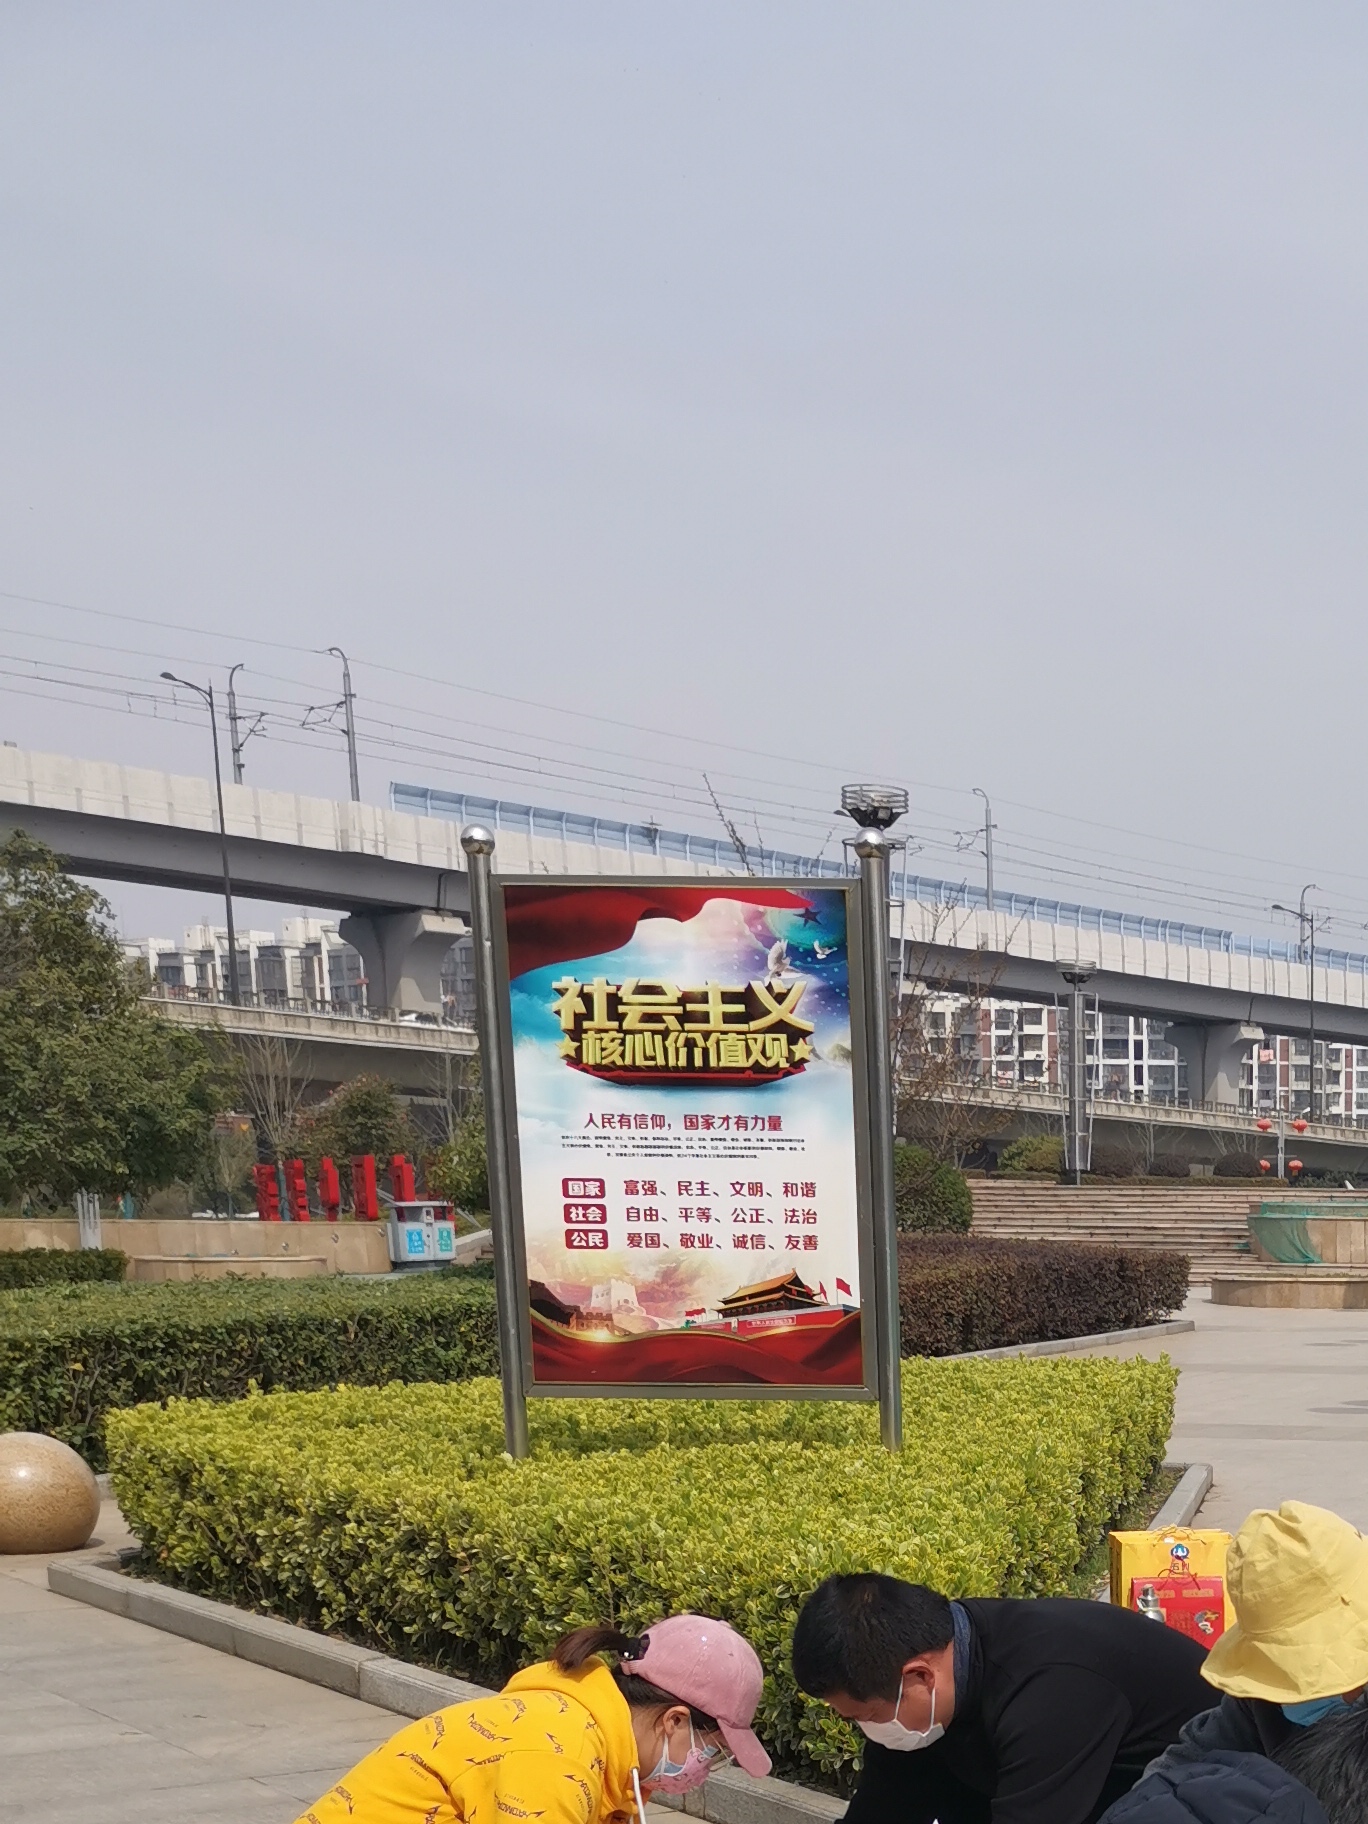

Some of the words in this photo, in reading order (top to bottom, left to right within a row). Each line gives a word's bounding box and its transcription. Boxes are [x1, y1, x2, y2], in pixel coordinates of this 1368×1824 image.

[552, 977, 815, 1033] 社会主义
[581, 1030, 790, 1069] 核心价值观
[583, 1112, 784, 1132] 人民有信仰，国家才有力量
[567, 1180, 602, 1196] 国家
[623, 1179, 818, 1198] 富强、民主、文明、和谐
[569, 1206, 603, 1222] 社会
[625, 1206, 819, 1225] 自由、平等、公正、法治
[570, 1231, 605, 1248] 公民
[626, 1232, 820, 1251] 爱国、敬业、诚信、友善
